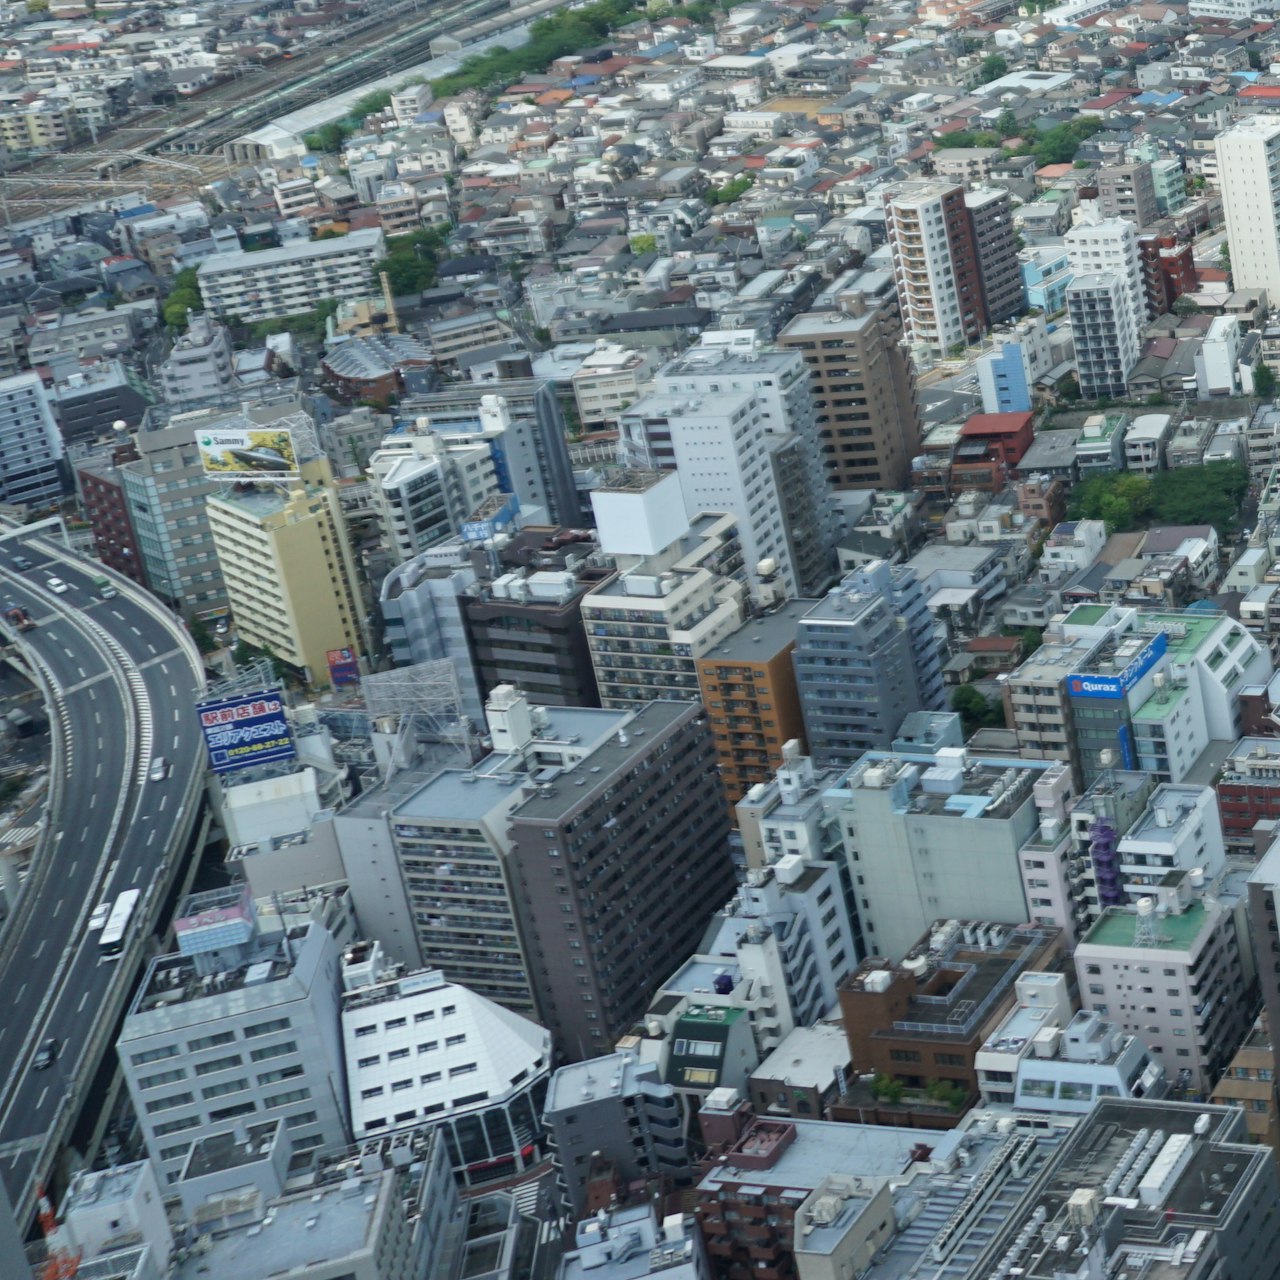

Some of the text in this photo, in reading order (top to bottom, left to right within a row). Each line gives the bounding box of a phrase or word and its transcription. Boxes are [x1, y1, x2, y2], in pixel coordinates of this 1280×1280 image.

[213, 437, 244, 446] Sammy
[1082, 682, 1117, 692] Quraz
[201, 700, 281, 726] 駅前店舗は
[208, 720, 286, 748] エリアクエスト
